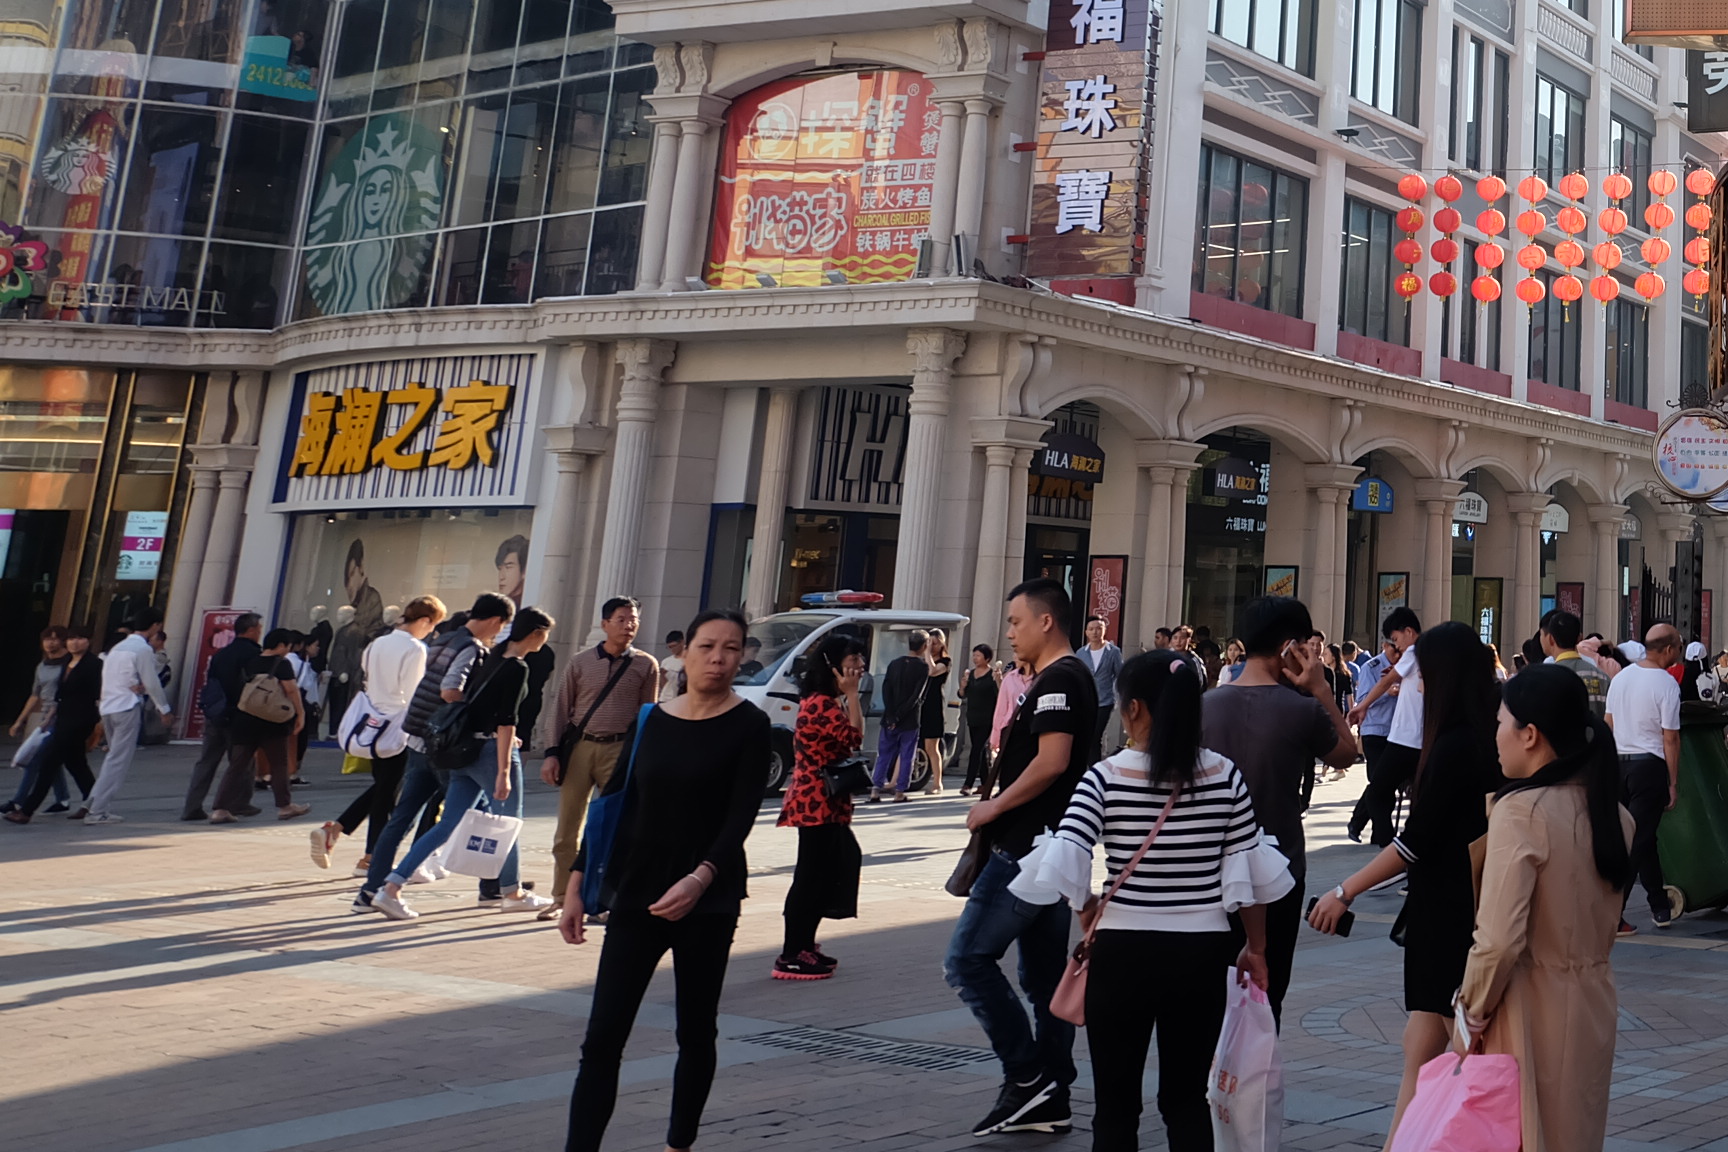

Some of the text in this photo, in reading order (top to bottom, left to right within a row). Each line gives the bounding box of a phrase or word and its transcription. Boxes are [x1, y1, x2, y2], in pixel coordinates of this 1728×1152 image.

[860, 186, 932, 210] 炭火烤鱼
[853, 210, 931, 229] CHARCOAL GRILLED FIS
[287, 379, 514, 478] 海澜之家
[1044, 449, 1069, 470] HLA
[1217, 472, 1234, 489] HLA
[136, 538, 155, 551] 2F
